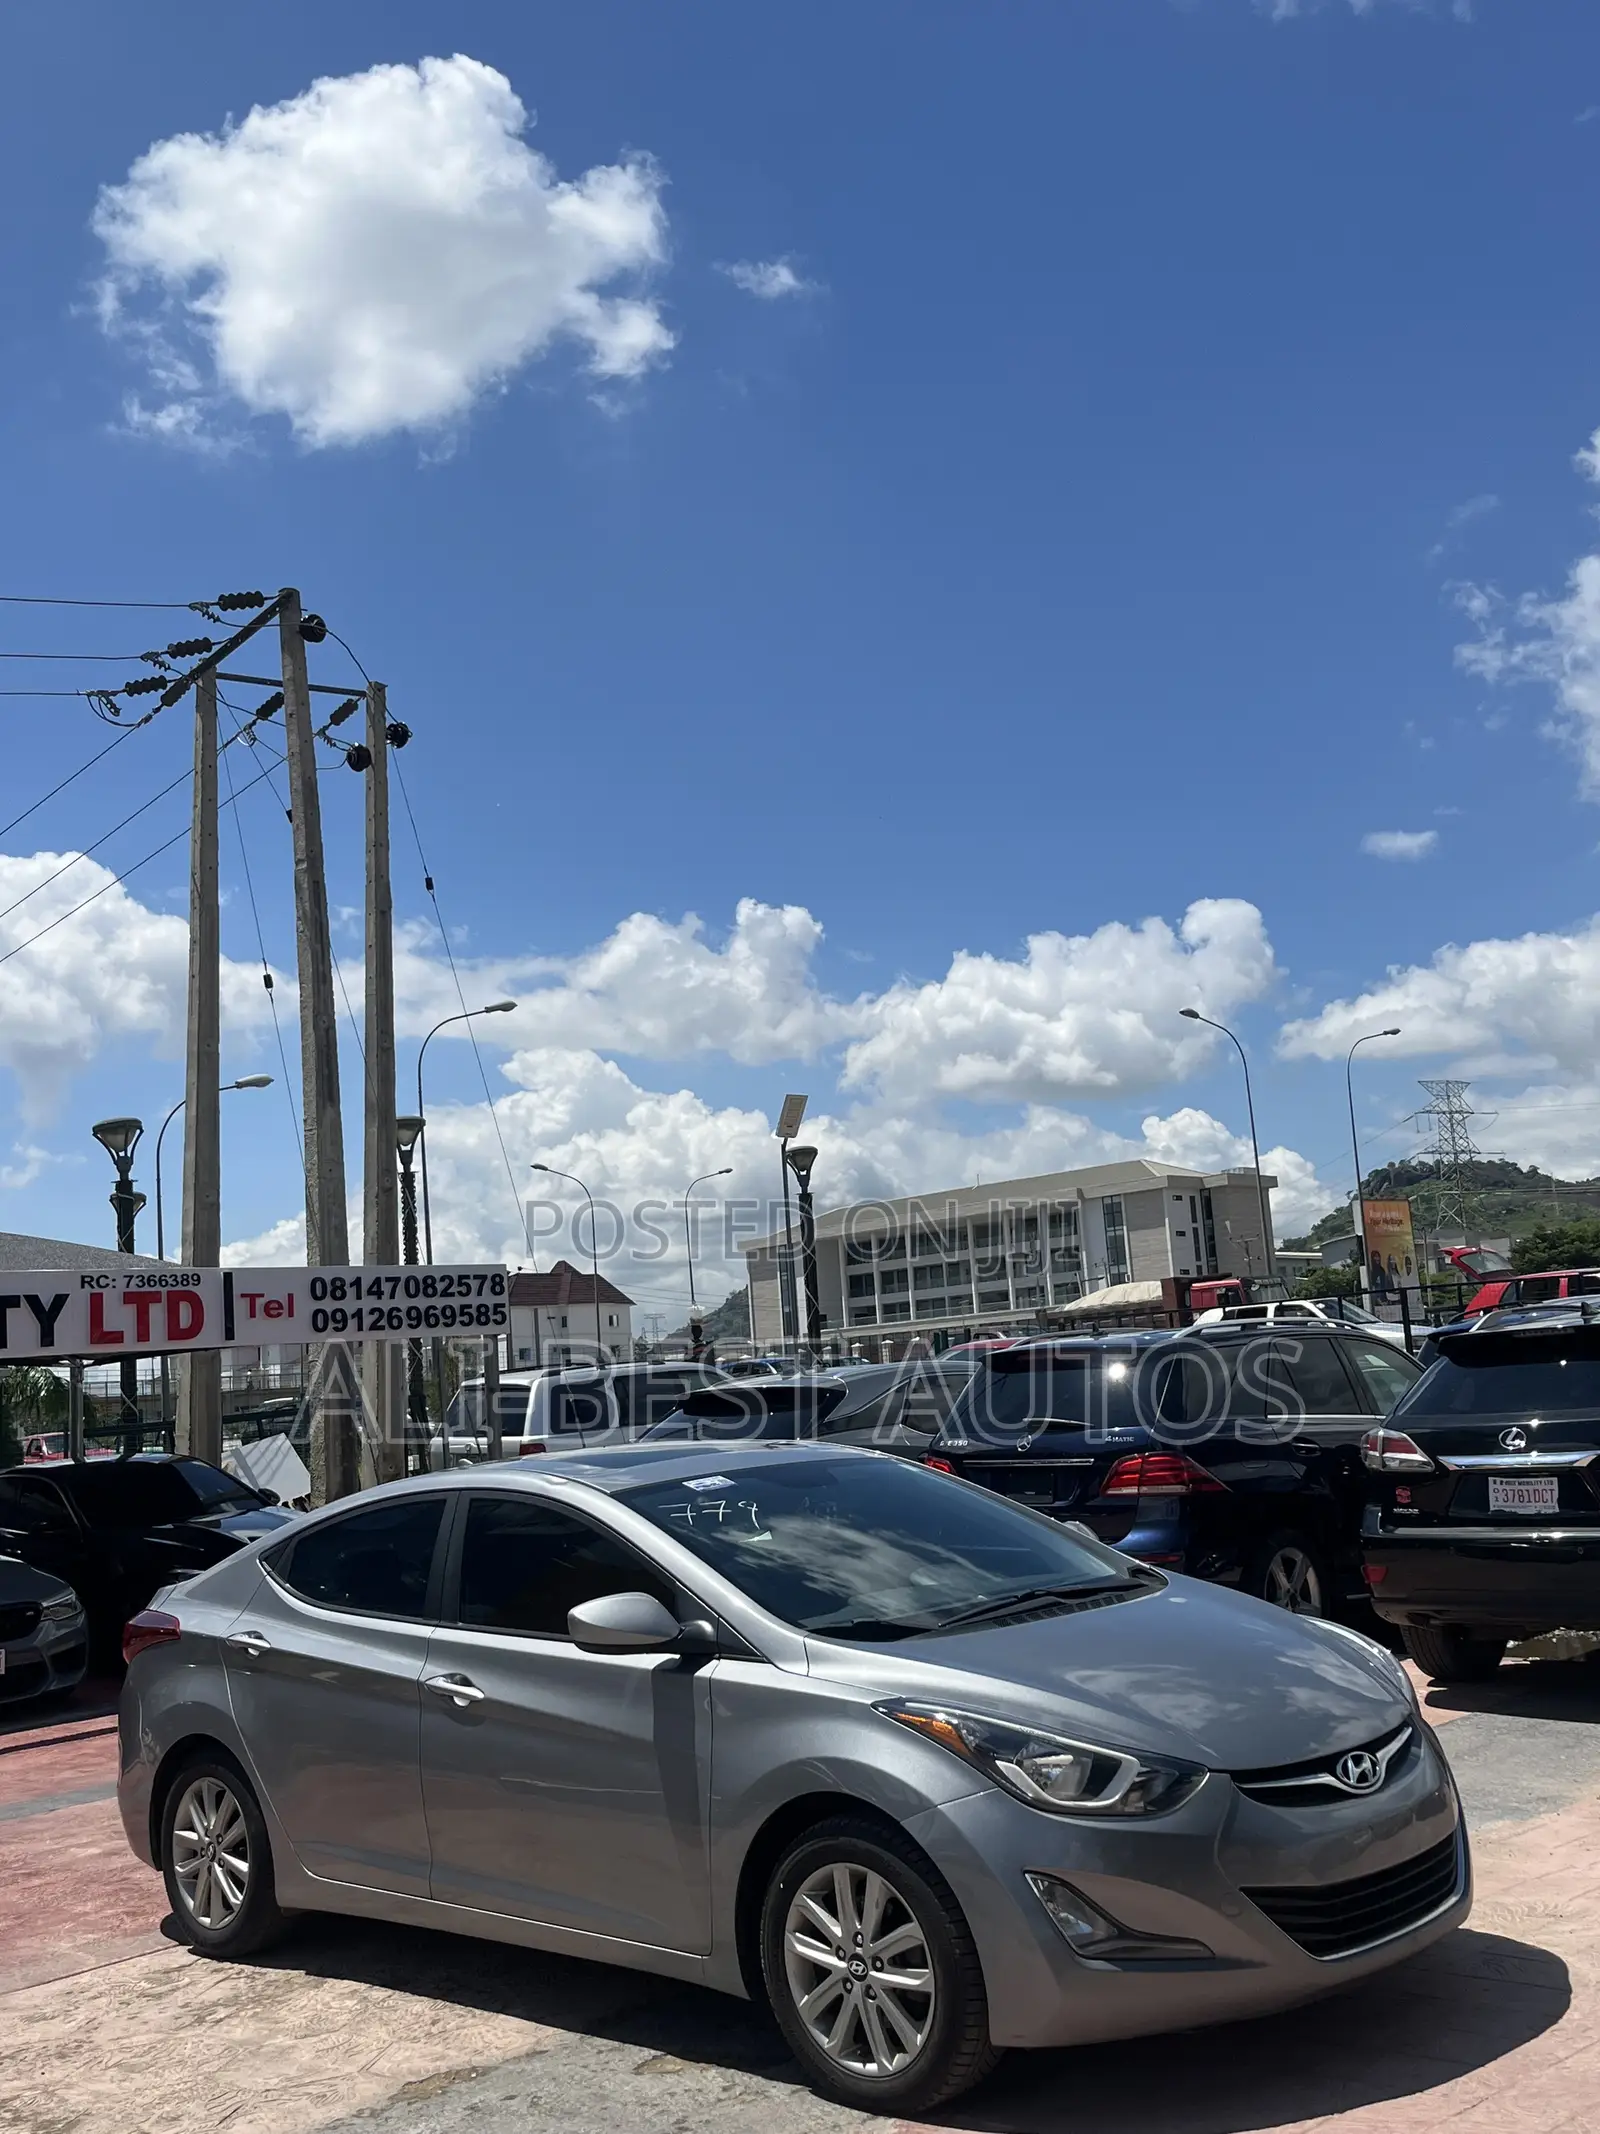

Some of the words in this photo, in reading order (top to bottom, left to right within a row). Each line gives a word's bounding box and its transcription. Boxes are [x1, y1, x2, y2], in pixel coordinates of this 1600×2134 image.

[80, 1274, 117, 1289] RC:
[123, 1273, 201, 1288] 7366389
[310, 1273, 505, 1301] 08147082578
[90, 1290, 204, 1344] LTD
[240, 1293, 294, 1318] Tel
[311, 1303, 507, 1333] 09126969585
[1104, 1435, 1135, 1443] 4MATIC
[1502, 1488, 1555, 1504] 3781DCT
